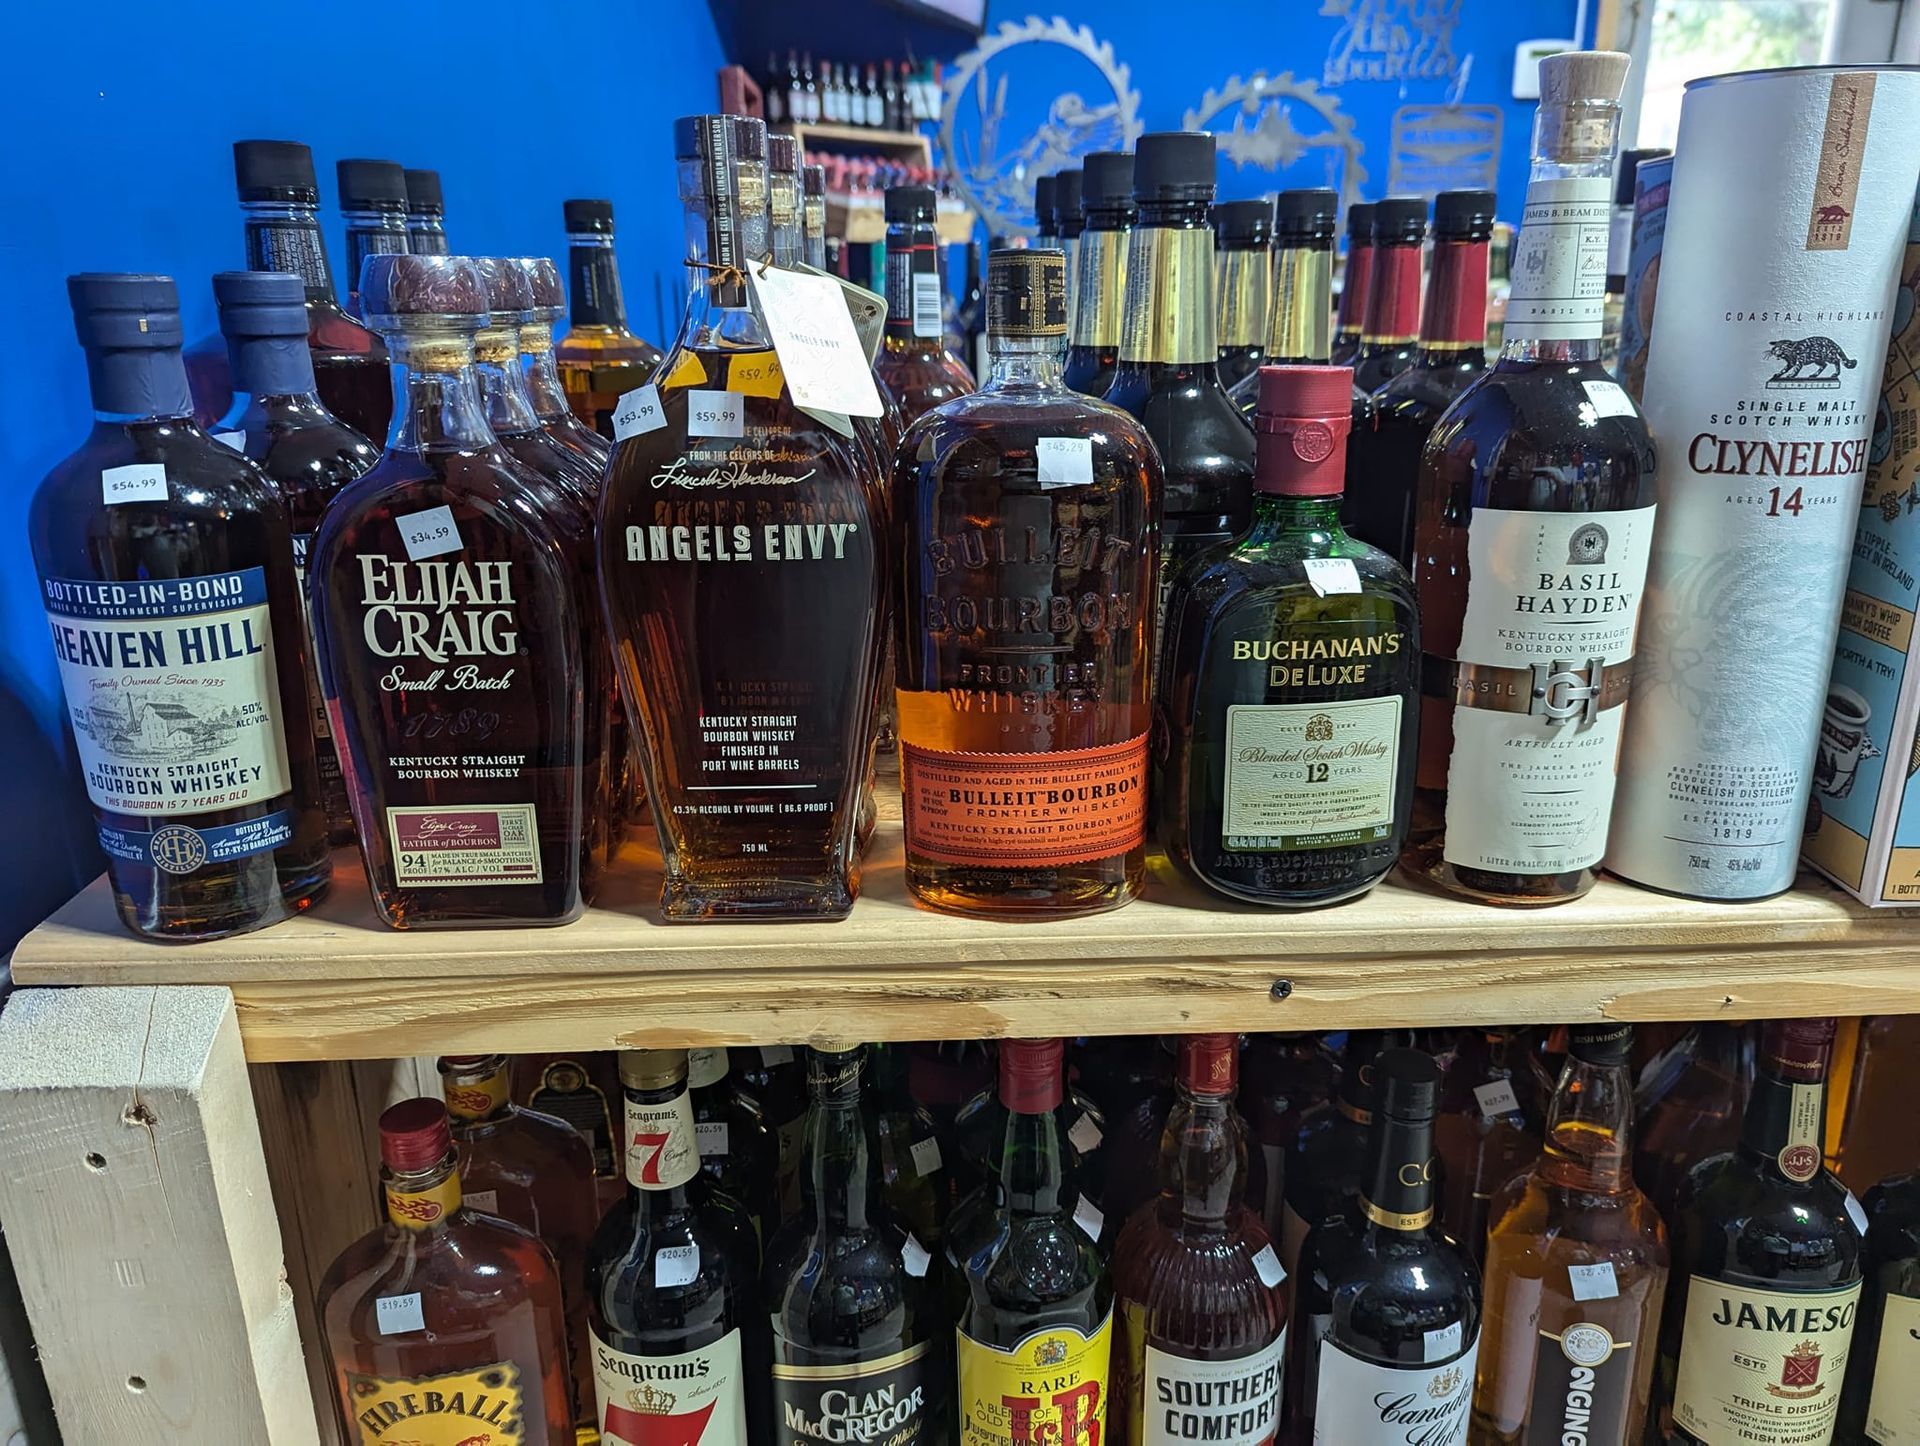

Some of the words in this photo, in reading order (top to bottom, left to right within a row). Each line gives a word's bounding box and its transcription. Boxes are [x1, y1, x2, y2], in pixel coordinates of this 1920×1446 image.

[711, 119, 723, 160] HENDERSON
[1563, 208, 1591, 217] BEAM
[1725, 311, 1803, 322] COASTAL
[1737, 400, 1806, 412] SINGLE
[1817, 400, 1856, 412] MALT
[619, 405, 654, 427] $53.99
[696, 410, 736, 423] $59.99
[1710, 414, 1792, 427] SCOTCH
[1807, 414, 1868, 427] WHISKY
[690, 450, 711, 461] FROM
[713, 450, 727, 461] THE
[729, 450, 763, 461] CELLARS
[1688, 432, 1868, 477] CLYNELISH
[111, 478, 157, 491] $54.99
[1726, 495, 1763, 505] AGED
[1765, 486, 1804, 517] 14
[1807, 495, 1837, 505] YEARS
[411, 526, 449, 545] $34.59
[625, 524, 752, 562] ANGELS
[764, 522, 848, 560] ENVY
[927, 525, 1133, 578] BULLEIT
[356, 554, 516, 615] ELIJAH
[1538, 573, 1622, 591] BASIL
[1880, 558, 1915, 592] IRELAND
[45, 575, 243, 605] BOTTLED-IN-BOND
[97, 605, 166, 617] GOVERNMENT
[172, 595, 244, 614] SUPERVISION
[926, 590, 1132, 634] BOURBON
[1515, 595, 1629, 615] HAYDEN
[363, 604, 517, 664] CRAIG
[1497, 628, 1576, 642] KENTUCKY
[1580, 626, 1631, 642] STRAIGHT
[1863, 619, 1893, 642] COFFEE
[51, 621, 168, 669] HEAVEN
[176, 617, 264, 666] HILL
[1232, 633, 1401, 661] BUCHANAN'S
[1505, 642, 1573, 654] BOURBON
[1579, 640, 1625, 653] WHISKEY
[89, 678, 120, 692] Family
[121, 674, 161, 688] Owned
[164, 673, 198, 687] Since
[201, 677, 226, 688] 1935
[380, 664, 446, 692] Small
[444, 664, 515, 691] Batch
[959, 661, 1098, 685] FRONTIER
[1452, 678, 1517, 696] BASIL
[242, 701, 263, 716] 50%
[699, 716, 748, 728] KENTUCKY
[751, 715, 798, 727] STRAIGHT
[703, 731, 749, 742] BOURBON
[752, 730, 795, 742] WHISKEY
[721, 745, 766, 757] FINISHED
[768, 745, 779, 757] IN
[1238, 746, 1300, 763] Blended
[1302, 744, 1345, 764] Scotch
[1345, 736, 1388, 760] Whisky
[98, 762, 160, 778] KENTUCKY
[167, 757, 240, 778] STRAIGHT
[389, 756, 458, 767] KENTUCKY
[462, 755, 527, 766] STRAIGHT
[702, 760, 727, 772] PORT
[730, 759, 755, 771] WINE
[757, 759, 800, 771] BARRELS
[90, 771, 163, 795] BOURBON
[171, 765, 262, 795] WHISKEY
[397, 769, 459, 780] BOURBON
[463, 768, 521, 779] WHISKEY
[984, 777, 1012, 786] AGED
[1028, 776, 1048, 785] THE
[1052, 773, 1092, 784] BULLEIT
[1094, 766, 1126, 779] FAMILY
[1272, 771, 1303, 780] AGED
[1305, 762, 1330, 784] 12
[1333, 766, 1362, 776] YEARS
[1667, 772, 1722, 786] PRODUCT
[105, 796, 120, 807] THIS
[122, 797, 163, 810] BOURBON
[167, 799, 176, 809] IS
[180, 799, 188, 809] 7
[193, 791, 225, 807] YEARS
[229, 789, 248, 802] OLD
[949, 788, 1036, 806] BULLEIT
[1046, 774, 1139, 805] BOURBON
[1670, 781, 1735, 798] CLYNELISH
[1739, 785, 1796, 799] DISTILLERY
[673, 804, 697, 815] 43.3%
[699, 804, 732, 814] ALCOHOL
[745, 803, 774, 814] VOLUME
[967, 808, 1050, 818] FRONTIER
[1059, 797, 1127, 816] WHISKEY
[929, 821, 988, 834] KENTUCKY
[992, 825, 1053, 835] STRAIGHT
[1058, 818, 1112, 833] BOURBON
[1683, 814, 1779, 827] ESTABLISHED
[402, 839, 439, 849] FATHER
[440, 838, 450, 849] of
[451, 837, 498, 848] BOURBON
[1712, 828, 1752, 839] 1819
[742, 844, 756, 853] 750
[401, 854, 427, 868] 94
[432, 866, 451, 874] 47%
[627, 1108, 677, 1123] Seagram's
[632, 1130, 672, 1185] 7
[661, 1248, 693, 1260] $20.59
[382, 1296, 414, 1311] $19.59
[597, 1346, 711, 1384] Seagram's
[1021, 1370, 1082, 1394] RARE
[820, 1383, 896, 1418] CLAN
[1732, 1394, 1783, 1414] TRIPLE
[359, 1391, 508, 1437] FIREBALL
[976, 1410, 1003, 1427] OLD
[988, 1403, 1030, 1419] BLEND
[1034, 1407, 1051, 1419] OF
[1165, 1389, 1278, 1441] COMFORT
[1722, 1406, 1758, 1423] SMOOTH
[1760, 1417, 1782, 1427] IRISH
[1727, 1417, 1749, 1428] JOHN
[1751, 1424, 1789, 1434] JAMESON
[1738, 1428, 1776, 1444] IRISH
[1780, 1427, 1827, 1444] WHISKEY
